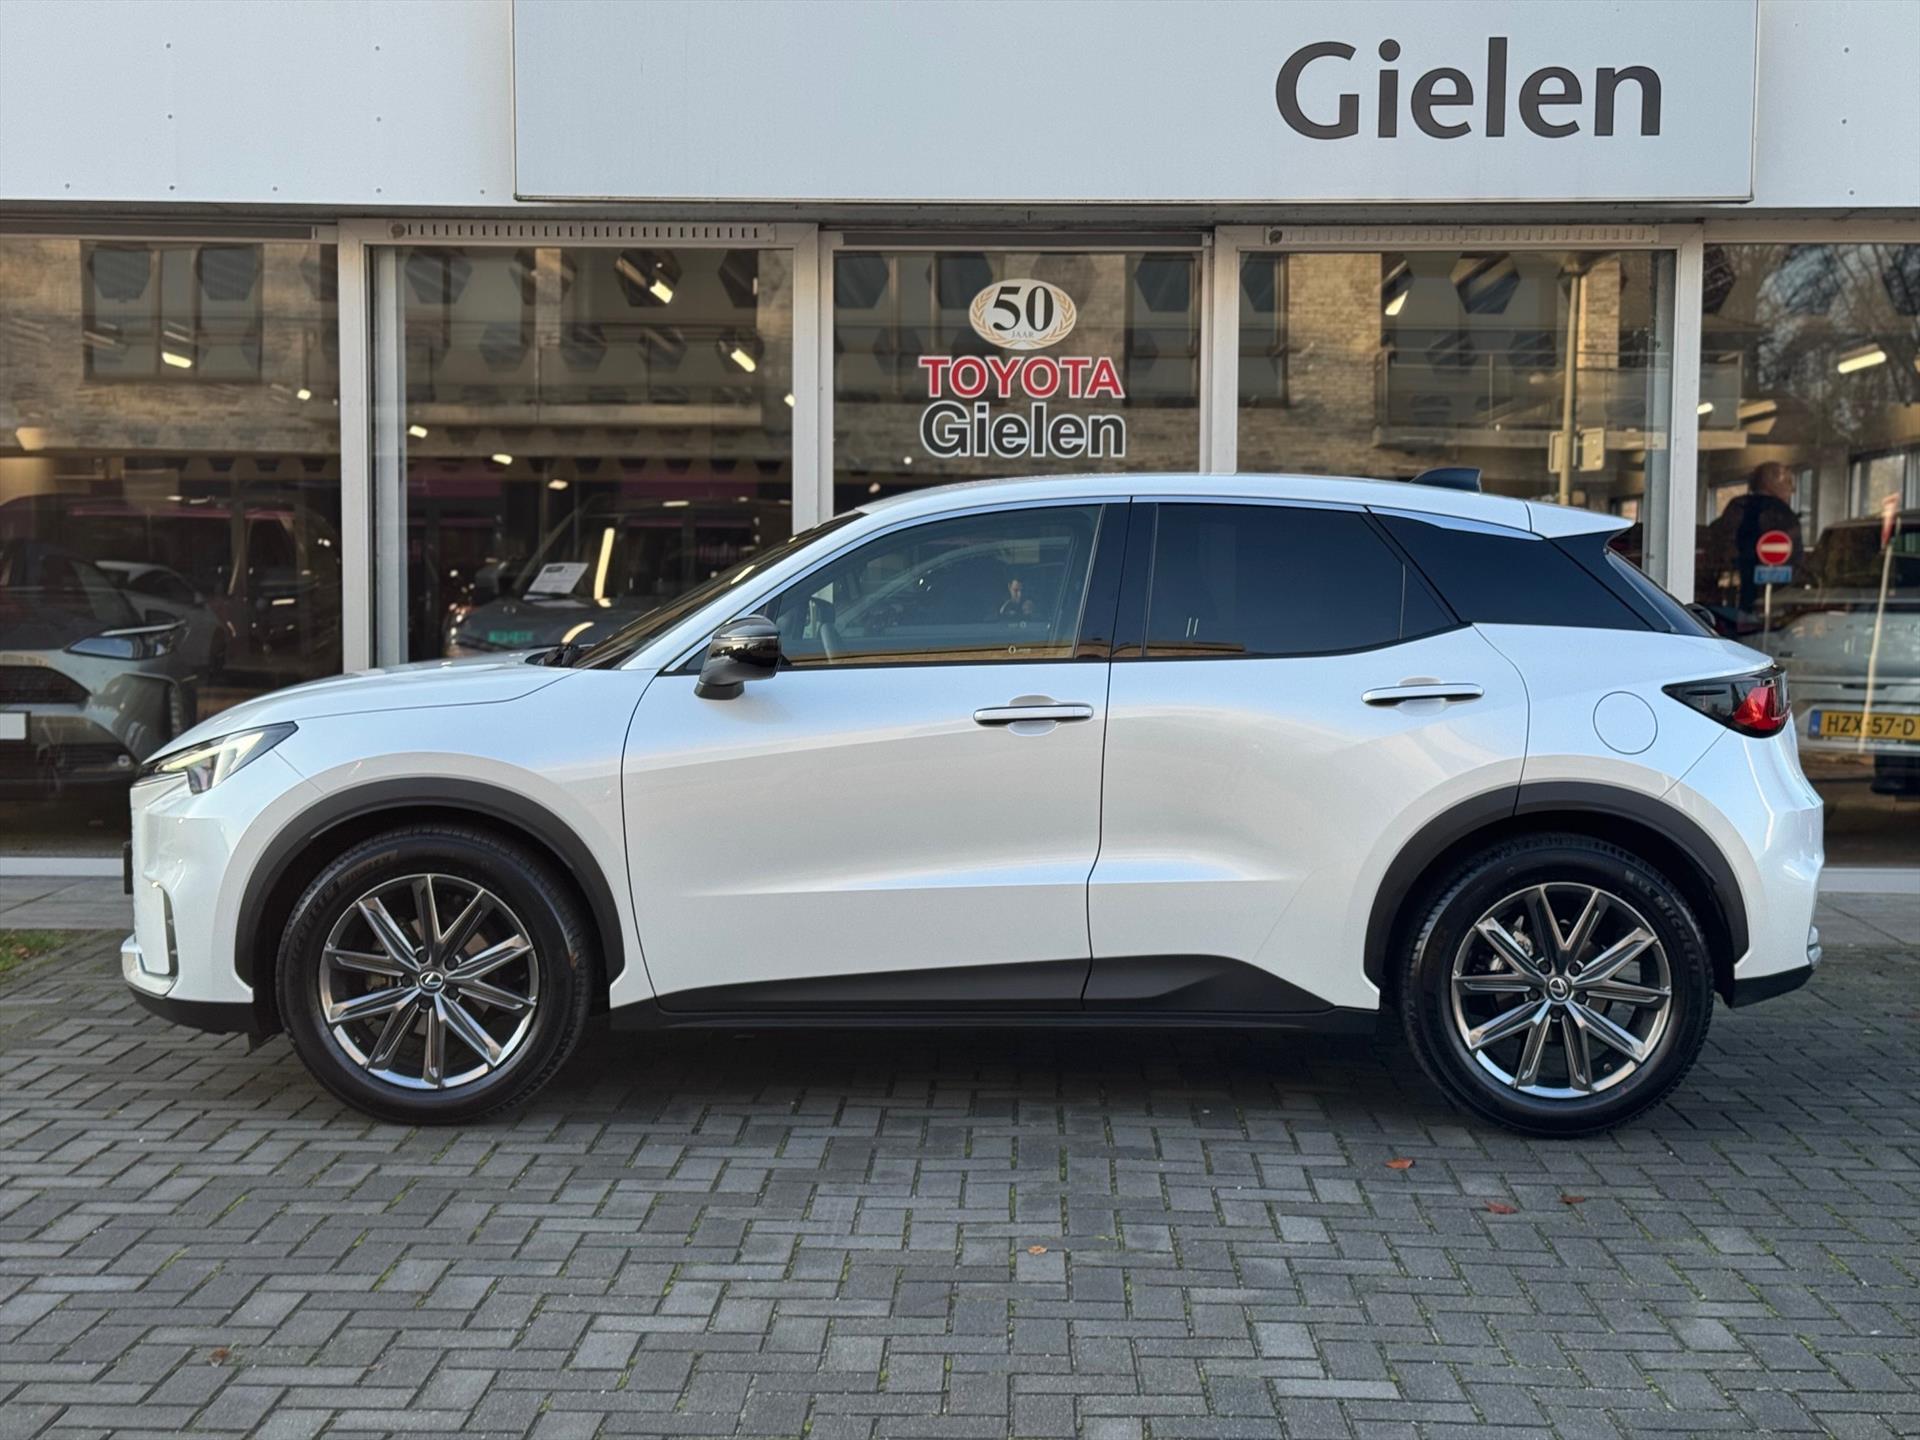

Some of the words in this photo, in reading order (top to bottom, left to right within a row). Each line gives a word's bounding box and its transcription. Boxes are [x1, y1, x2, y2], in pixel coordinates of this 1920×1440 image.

[1276, 36, 1662, 139] Gielen
[993, 286, 1054, 332] 50
[1010, 330, 1034, 339] JAAR
[918, 355, 1126, 399] TOYOTA
[920, 400, 1126, 458] Gielen
[1826, 714, 1916, 737] HZX-57-D
